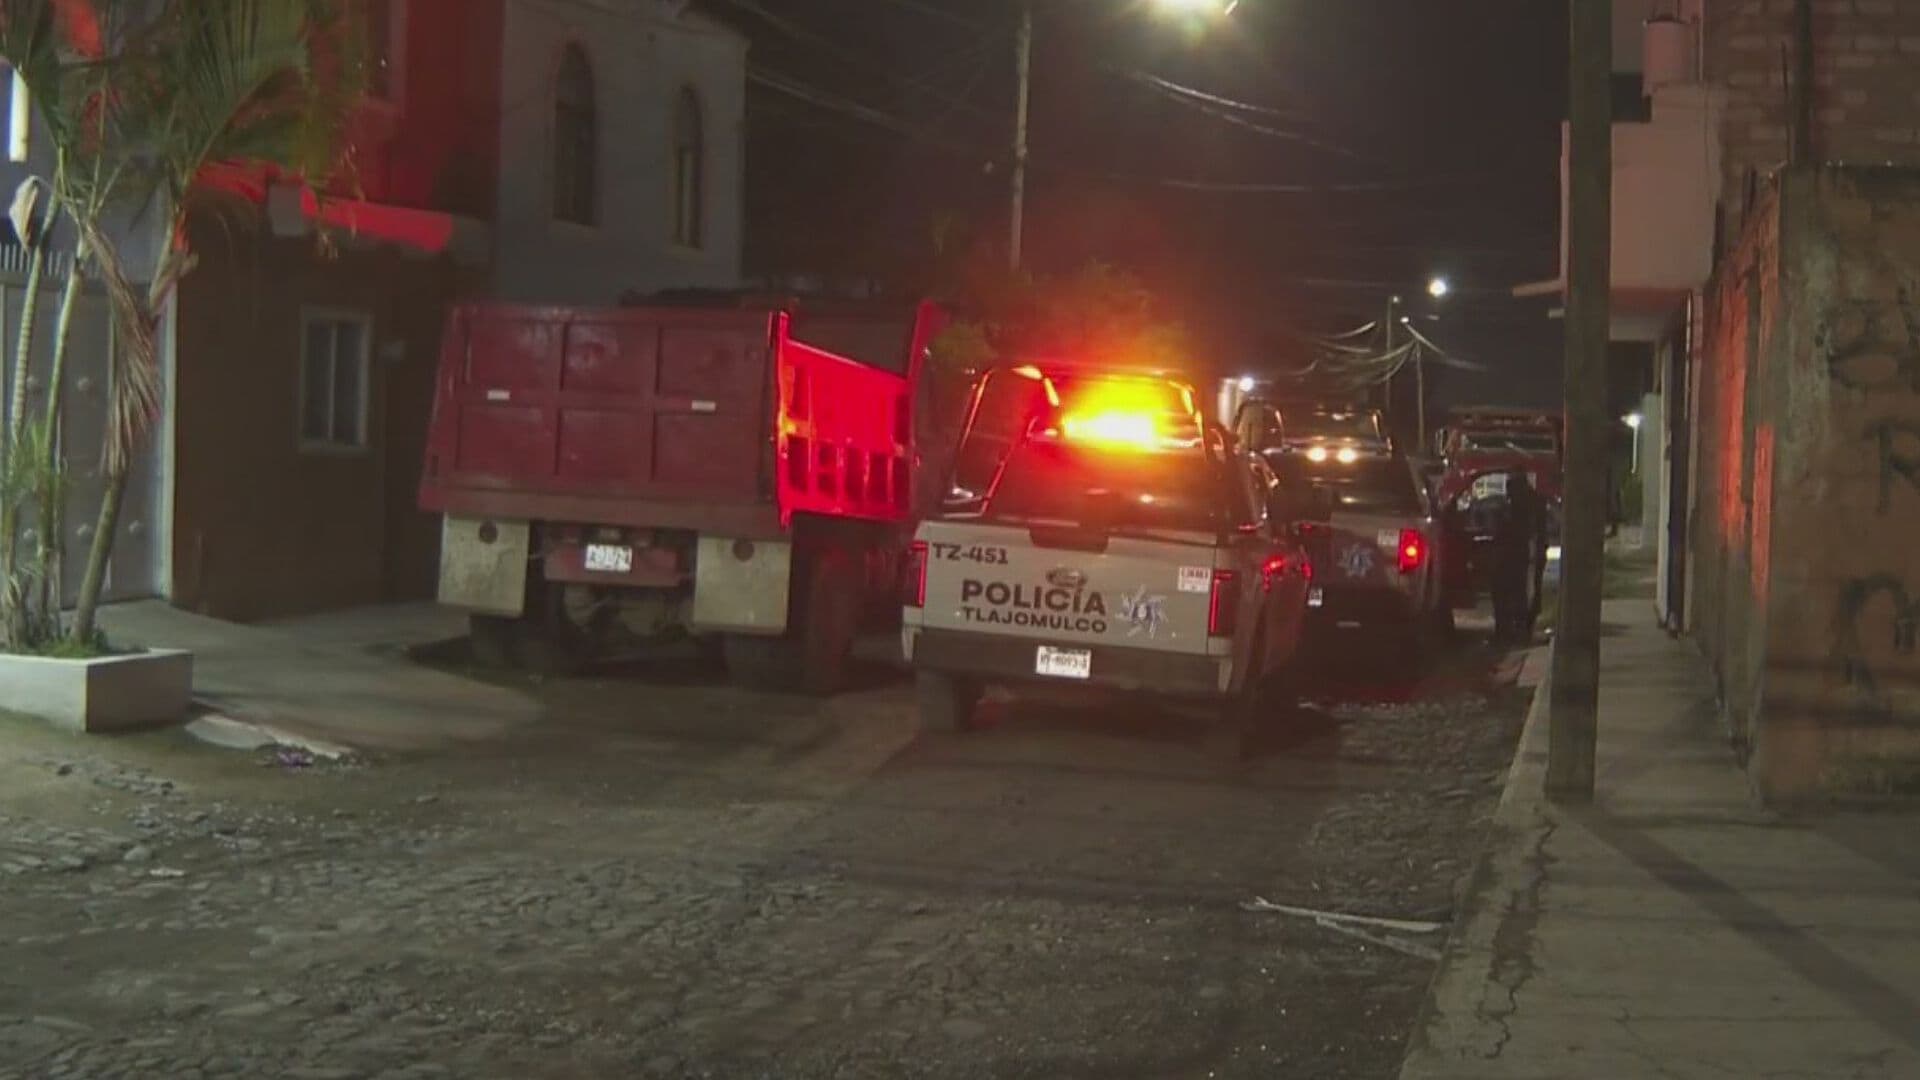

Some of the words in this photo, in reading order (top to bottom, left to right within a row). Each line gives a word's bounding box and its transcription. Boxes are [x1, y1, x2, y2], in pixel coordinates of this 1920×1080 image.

[931, 542, 1009, 565] TZ-451
[961, 579, 1107, 616] POLICÍA
[963, 606, 1107, 633] TLAJOMULCO
